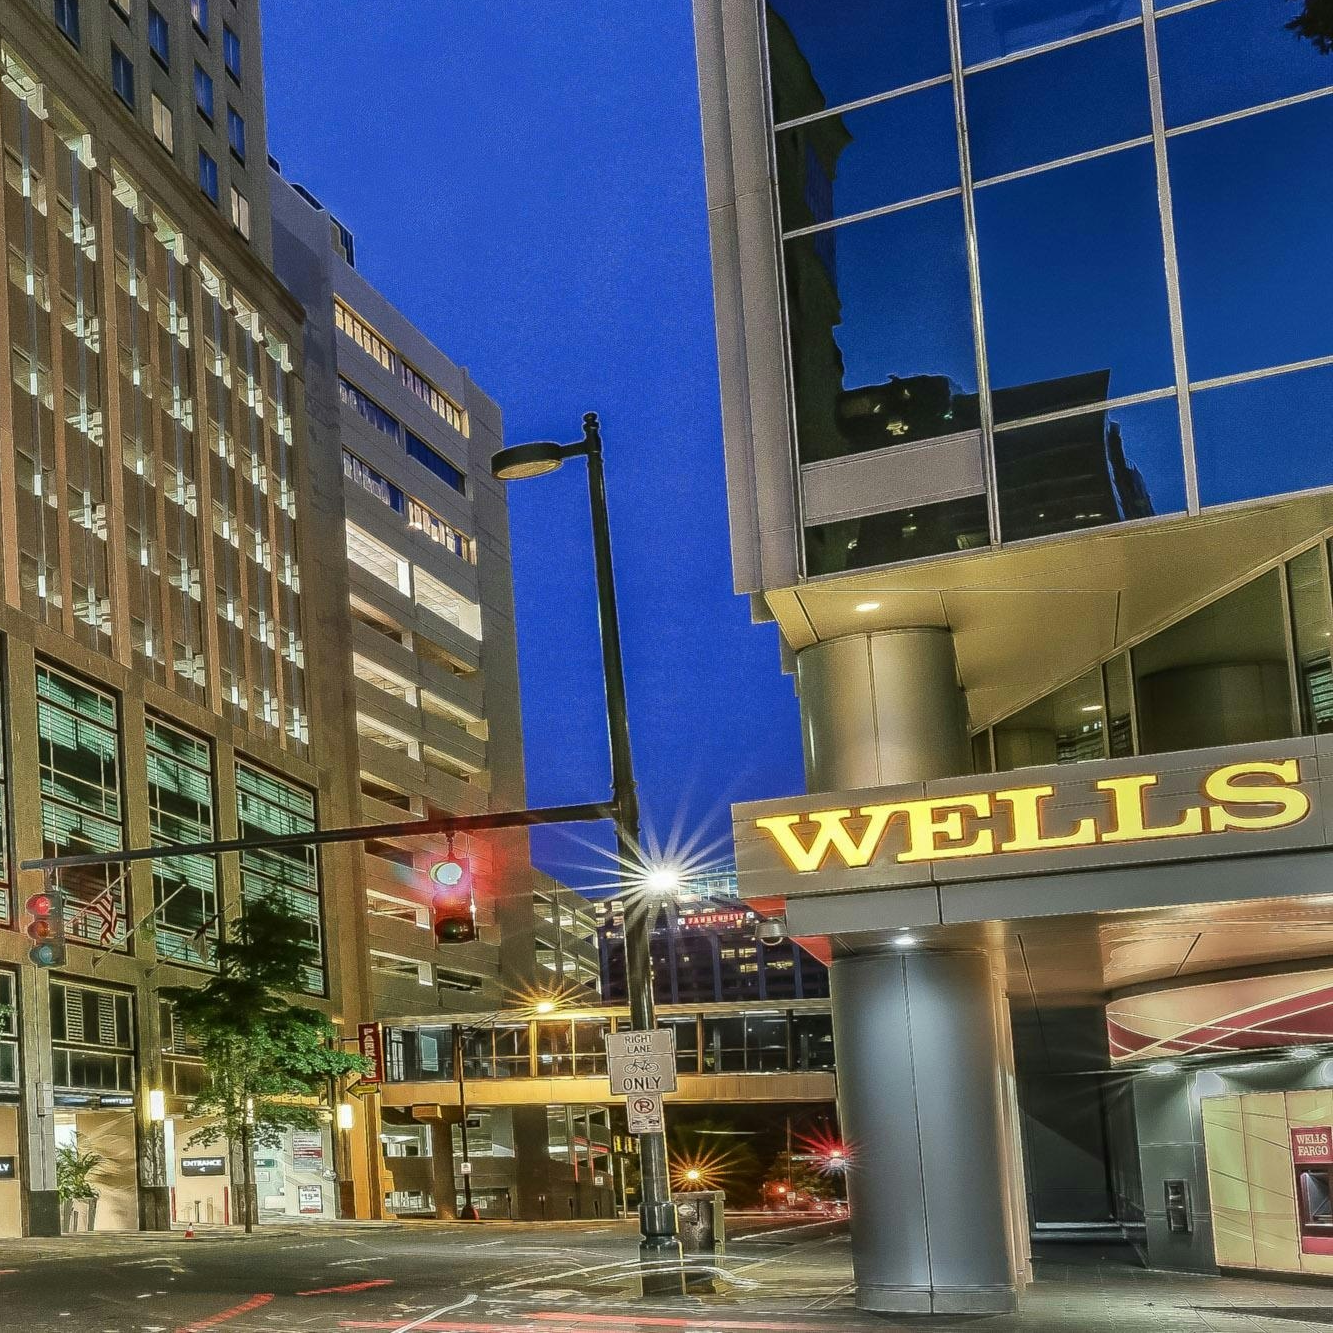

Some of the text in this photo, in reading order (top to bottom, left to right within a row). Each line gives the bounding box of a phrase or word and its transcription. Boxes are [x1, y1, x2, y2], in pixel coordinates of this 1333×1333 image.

[755, 758, 1310, 872] WELLS
[624, 1035, 653, 1045] RIGHT
[627, 1045, 652, 1054] LANE
[623, 1076, 662, 1091] ONLY
[1296, 1133, 1328, 1145] WELLS
[1298, 1145, 1329, 1156] FARGO
[182, 1159, 222, 1167] ENTRANCE
